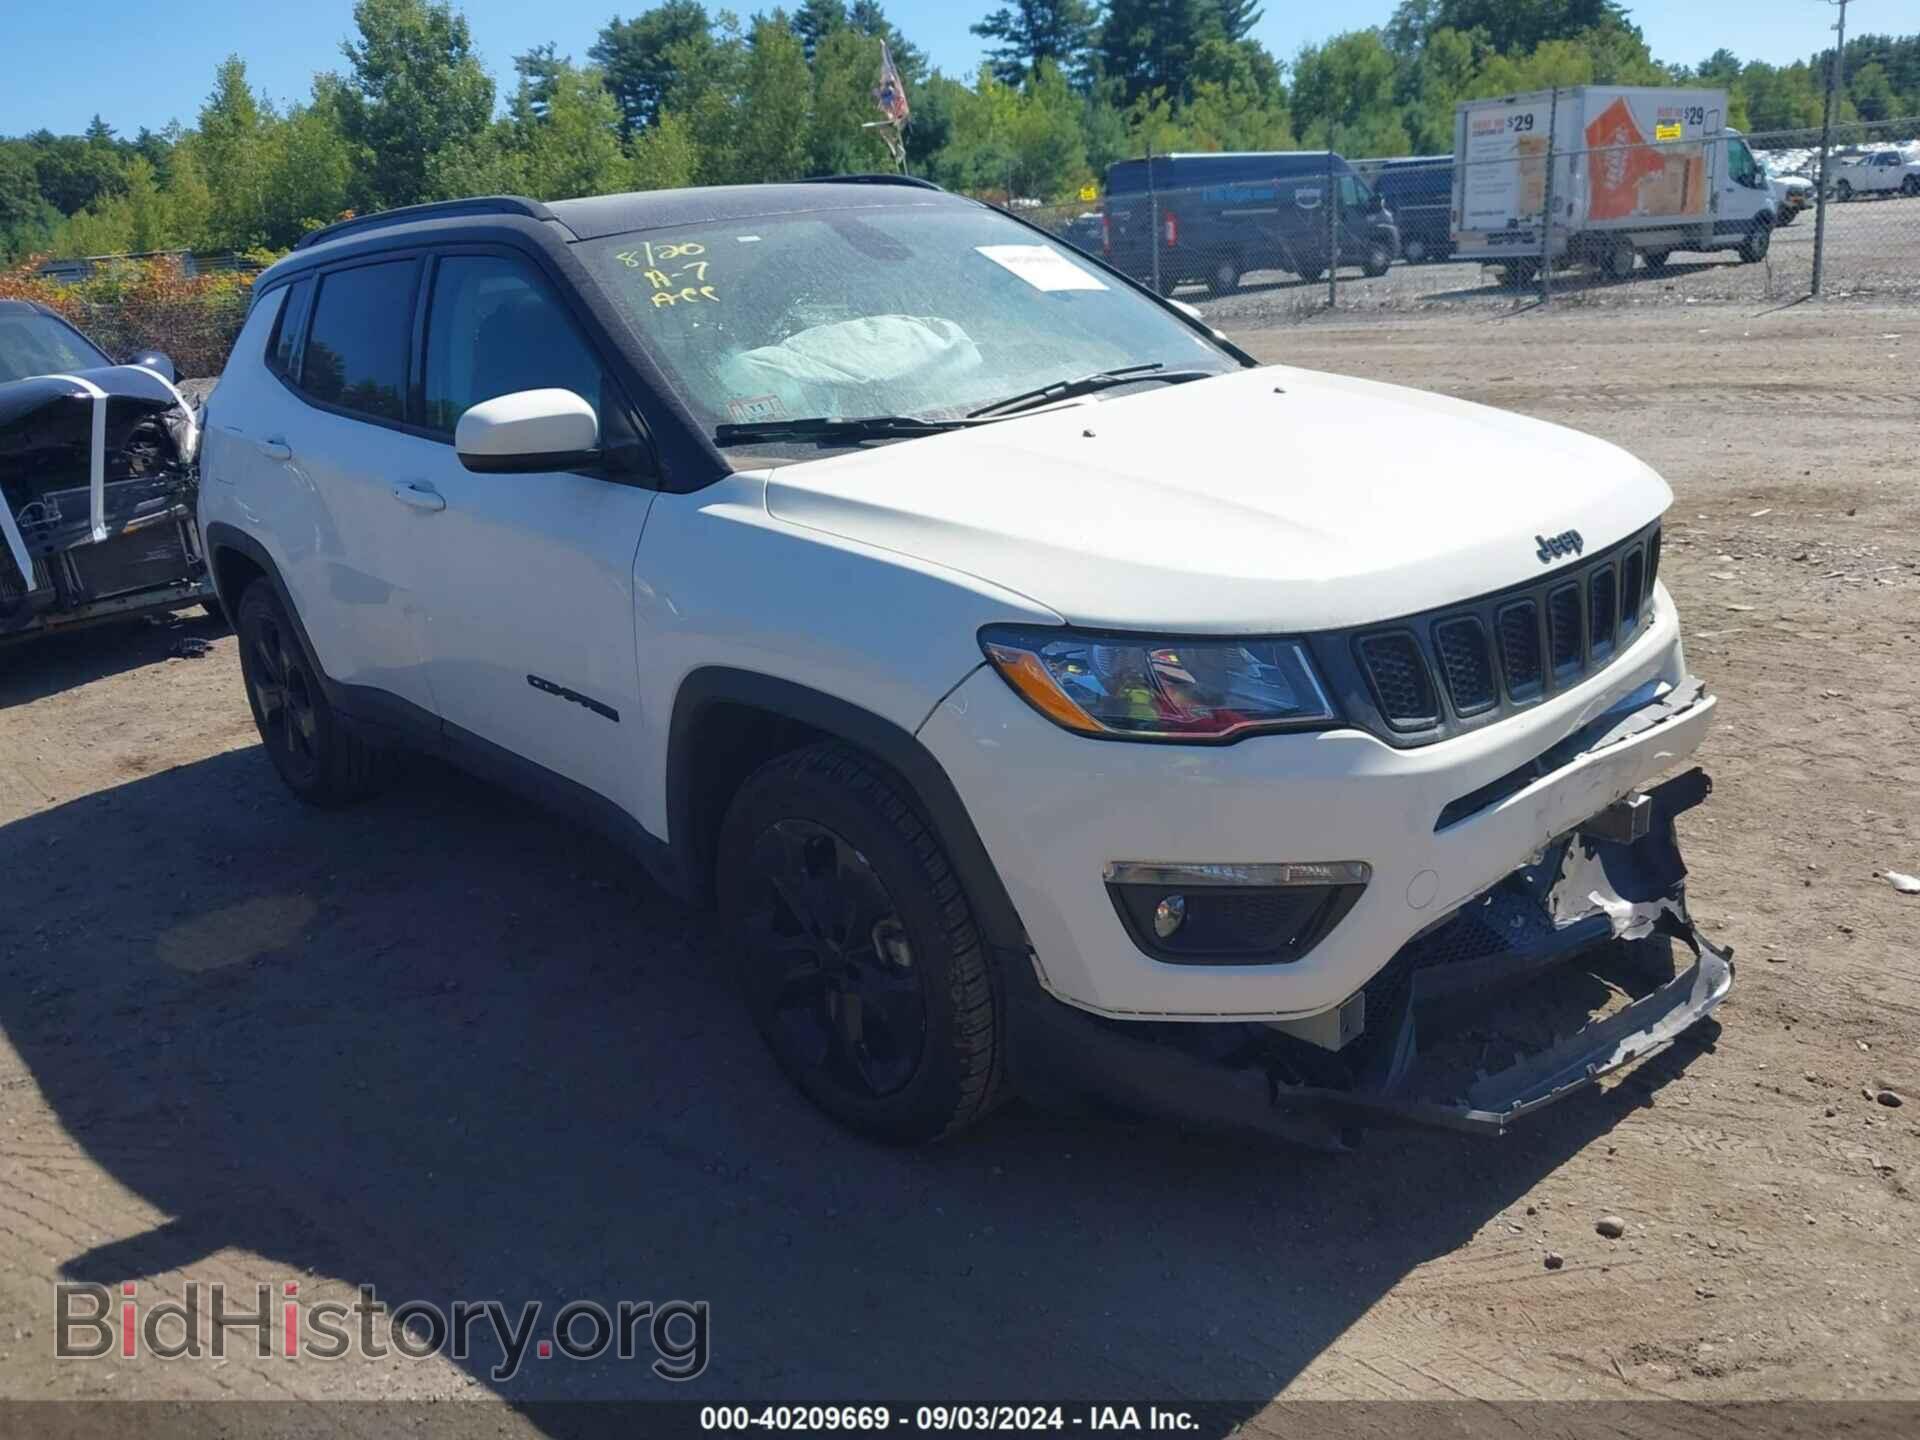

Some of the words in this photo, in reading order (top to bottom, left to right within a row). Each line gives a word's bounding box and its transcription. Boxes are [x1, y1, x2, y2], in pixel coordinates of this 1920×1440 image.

[1506, 113, 1534, 132] $29
[1684, 106, 1704, 125] $29
[1535, 529, 1584, 565] Jeep
